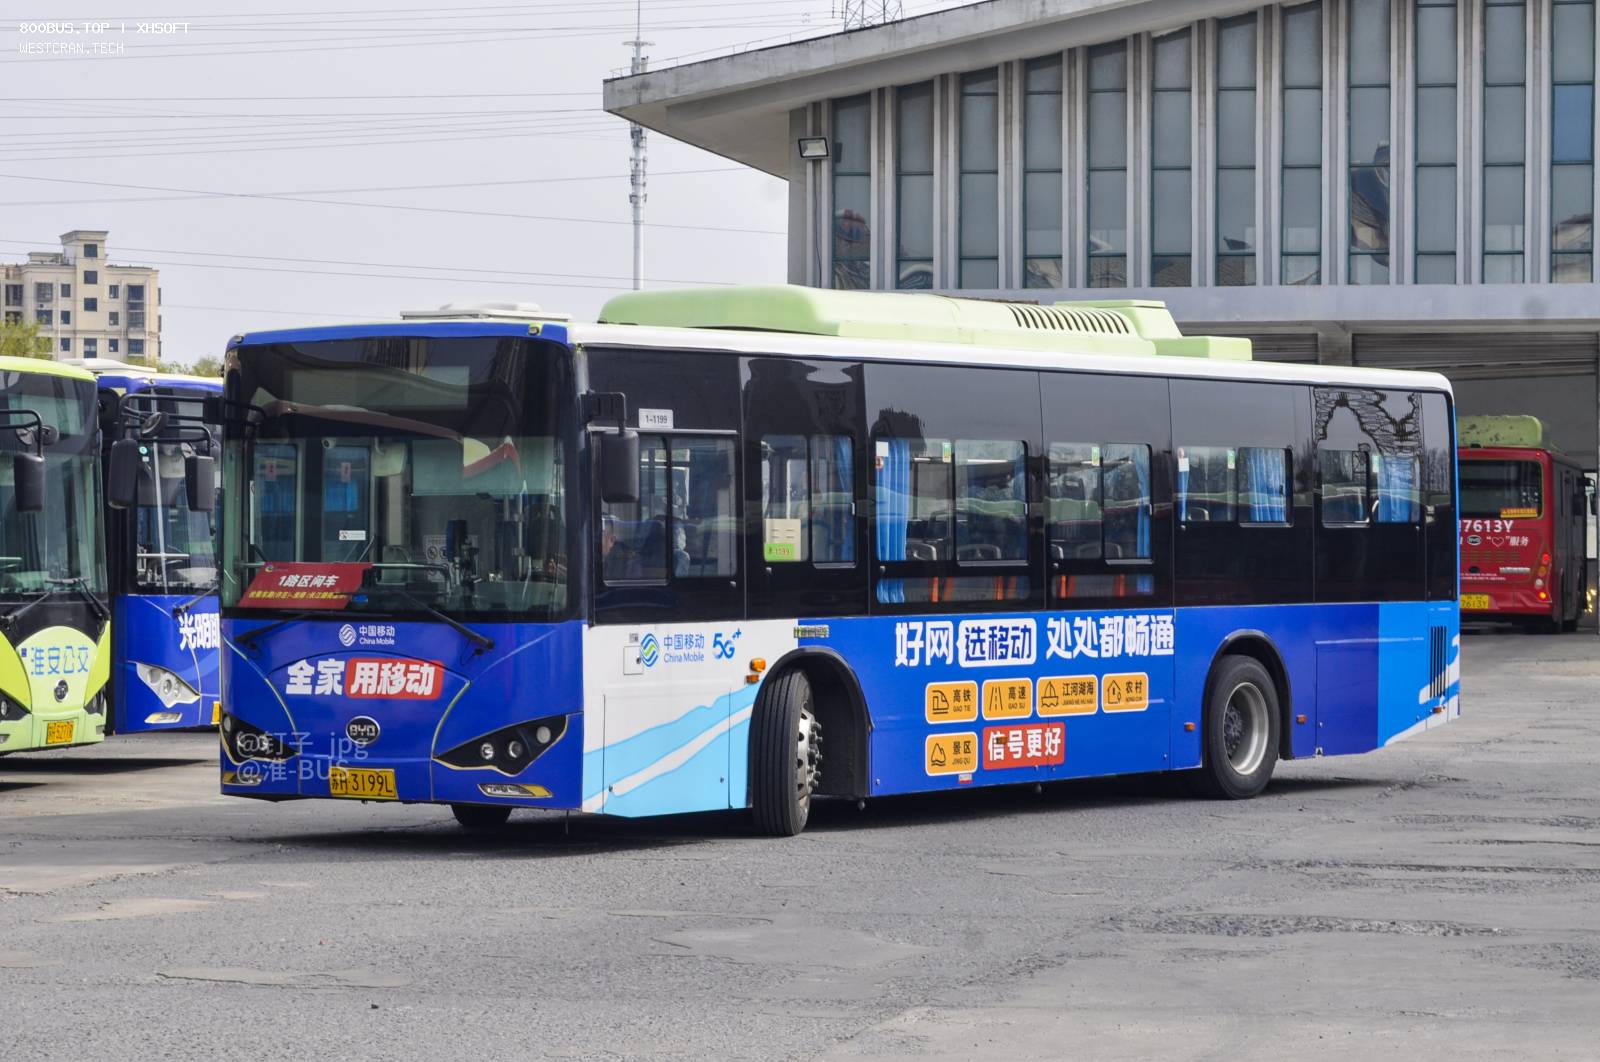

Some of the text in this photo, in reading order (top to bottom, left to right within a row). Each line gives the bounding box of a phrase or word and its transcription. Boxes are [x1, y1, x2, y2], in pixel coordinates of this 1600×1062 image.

[645, 414, 668, 425] 1-1199
[1458, 518, 1514, 533] 7613Y
[359, 625, 395, 637] 中国移动
[359, 637, 395, 645] China Mobile
[663, 634, 705, 650] 中国移动
[895, 614, 1174, 667] 好网 选移动 处处都畅通
[31, 645, 89, 676] 淮安公交
[663, 652, 705, 663] China Mobile
[286, 659, 436, 696] 全家 用移动
[1008, 685, 1027, 700] 高速
[1062, 681, 1095, 697] 江河湖海
[1126, 680, 1143, 695] 农村
[953, 689, 972, 703] 高铁
[350, 725, 376, 736] BYD
[953, 740, 971, 754] 景区
[988, 727, 1061, 761] 信号更好
